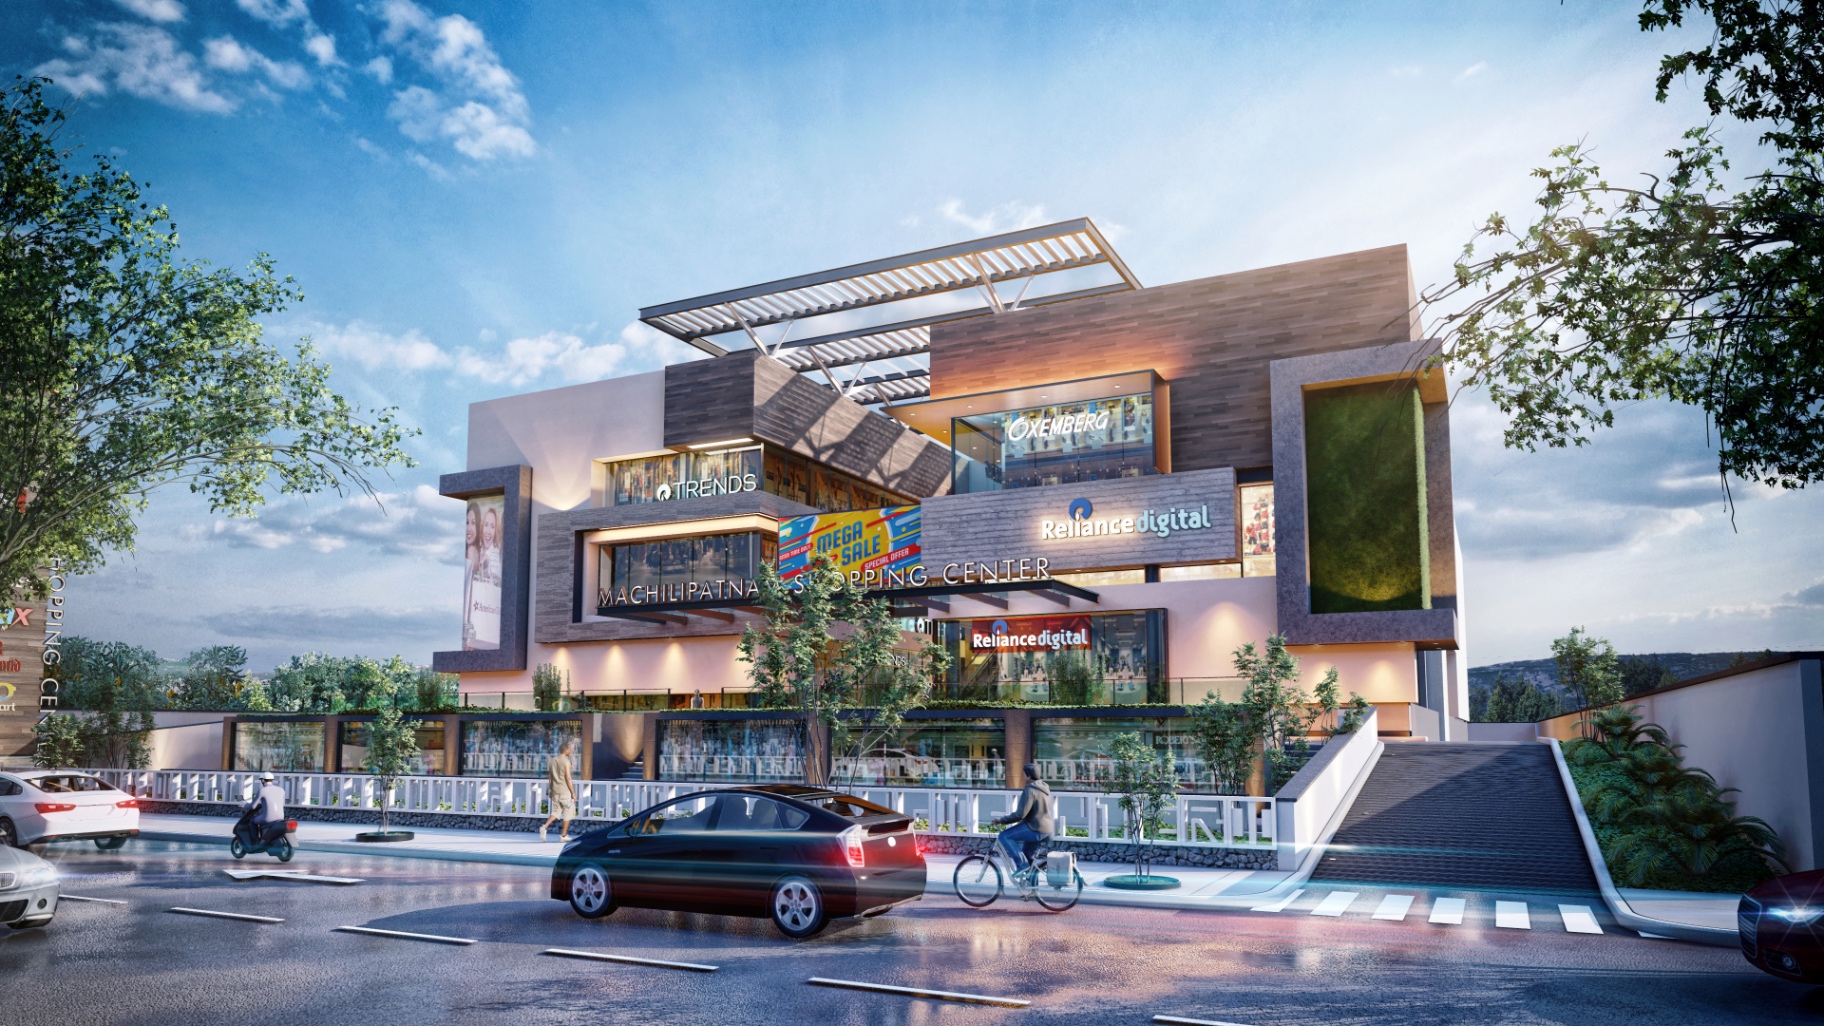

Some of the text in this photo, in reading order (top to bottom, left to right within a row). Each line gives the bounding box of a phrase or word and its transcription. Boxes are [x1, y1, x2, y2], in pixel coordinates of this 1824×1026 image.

[1008, 411, 1111, 442] OXEMBERG
[673, 474, 757, 499] TRENDS
[817, 520, 863, 553] MEGA
[841, 534, 881, 566] SALE
[863, 548, 909, 571] SPECIAL OFFER
[598, 578, 781, 607] MACHILIPATNA
[943, 557, 1051, 585] CENTER
[42, 557, 66, 665] HOPPING
